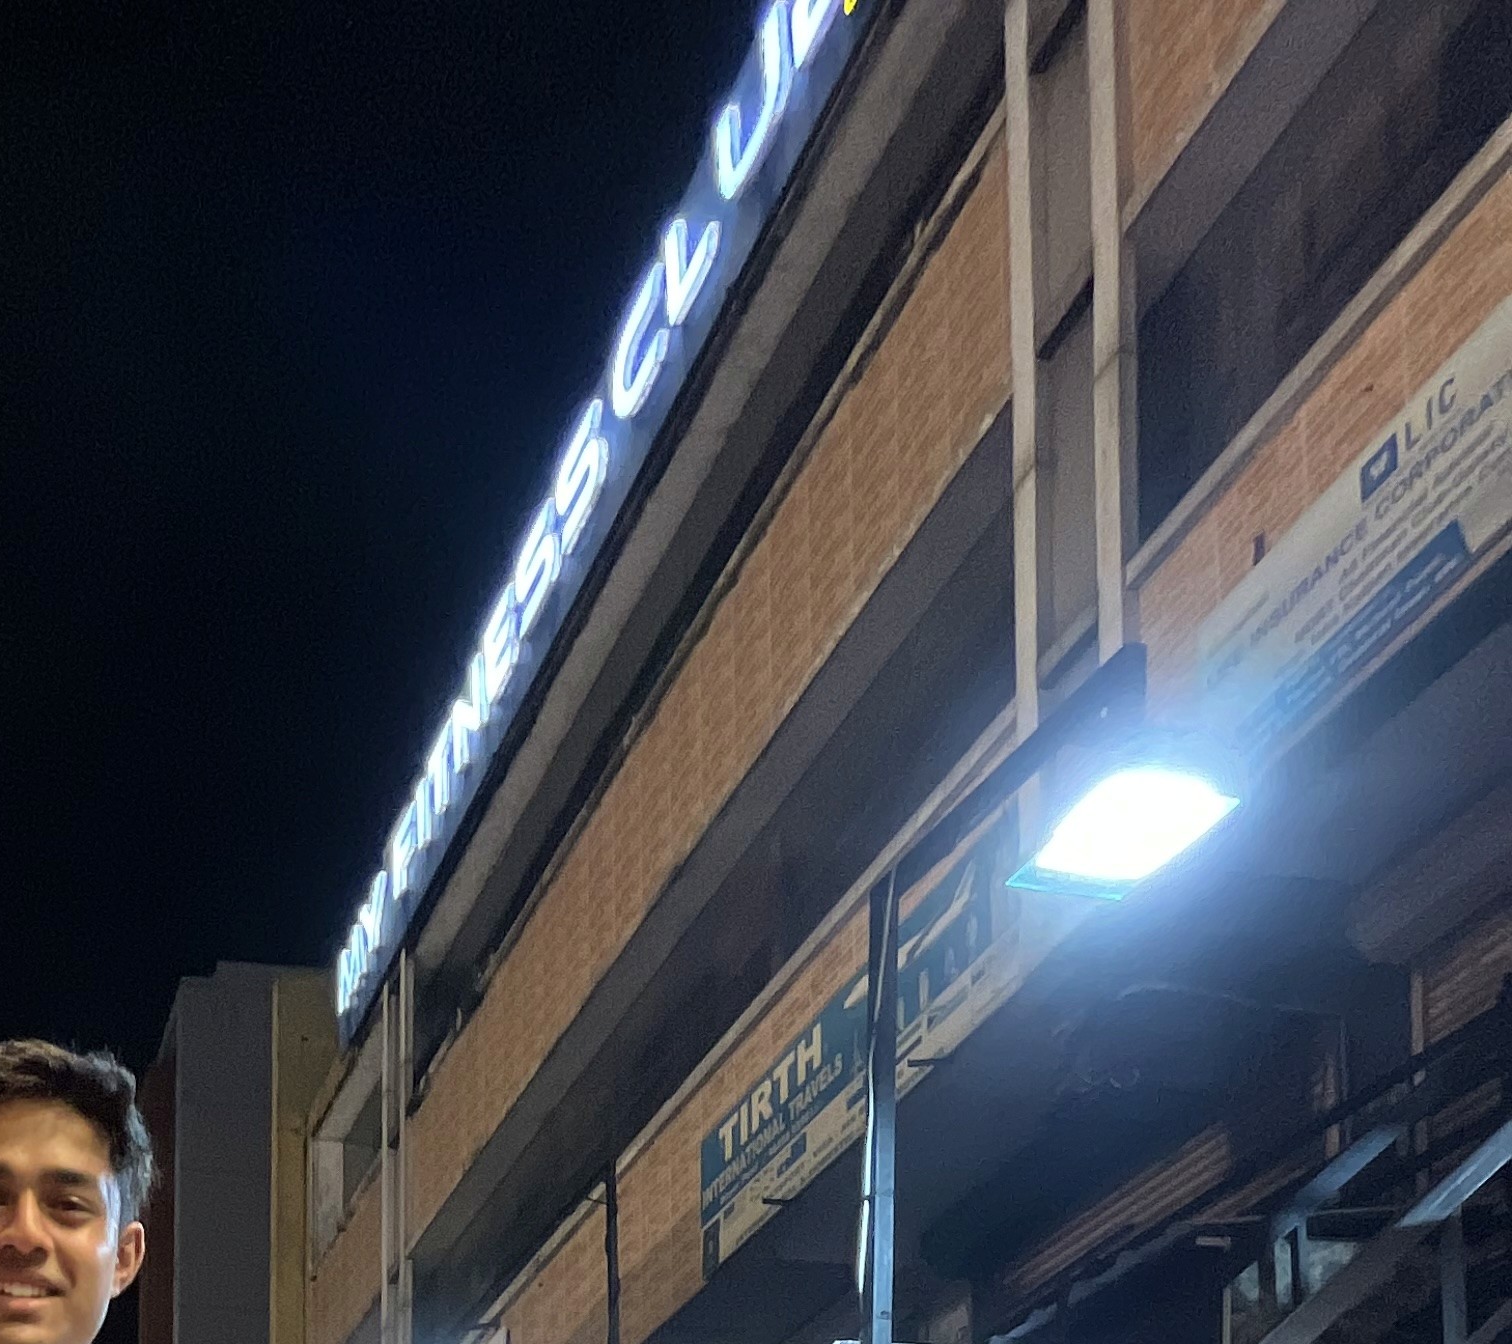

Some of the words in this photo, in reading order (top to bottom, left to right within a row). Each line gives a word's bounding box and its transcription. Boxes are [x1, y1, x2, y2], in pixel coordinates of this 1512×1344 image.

[1404, 374, 1458, 451] LIC
[1250, 516, 1368, 647] INSURANCE
[336, 869, 388, 1017] MY
[390, 398, 609, 901] FITNESS
[702, 1112, 787, 1211] INTERNATIONAL
[788, 1052, 844, 1122] TRAVELS
[718, 1022, 823, 1162] TIRTH
